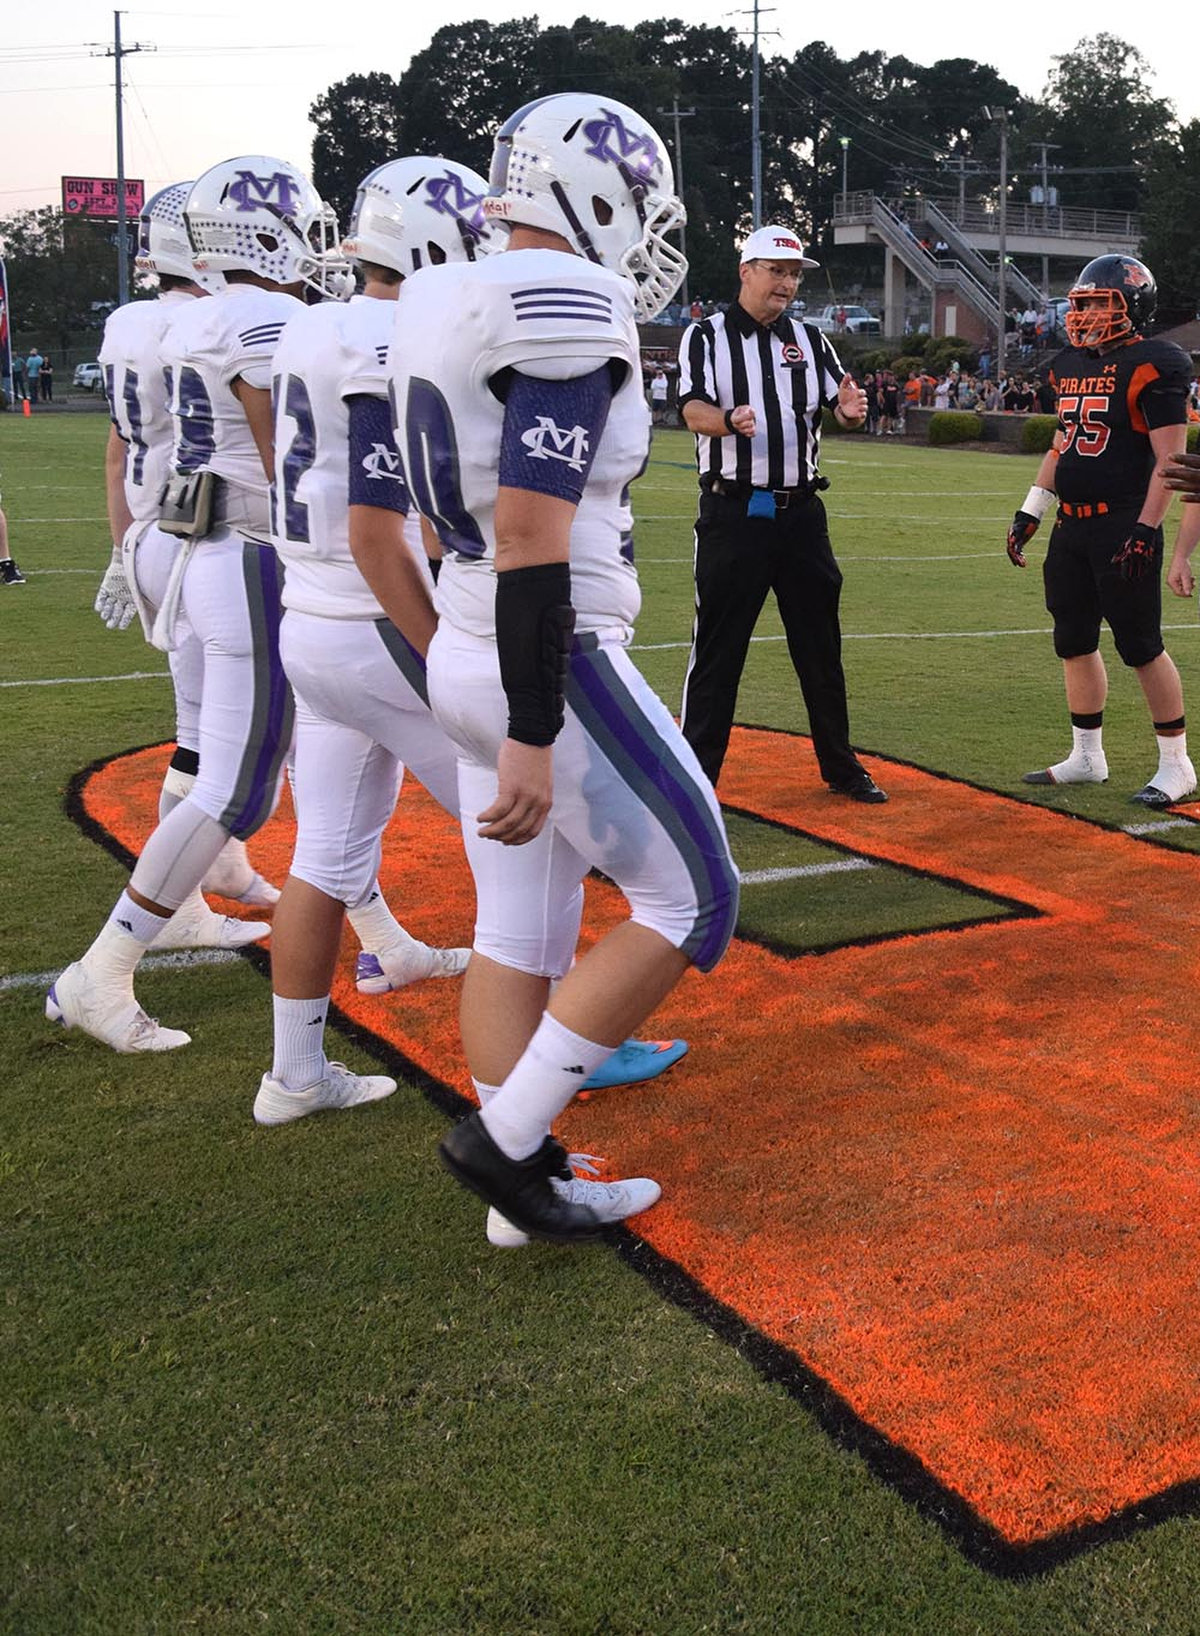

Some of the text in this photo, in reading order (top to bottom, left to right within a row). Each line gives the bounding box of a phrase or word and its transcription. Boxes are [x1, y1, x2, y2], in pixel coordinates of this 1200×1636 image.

[67, 181, 138, 196] GUN SHW
[1058, 376, 1116, 395] PIRATES
[1058, 396, 1111, 458] 55
